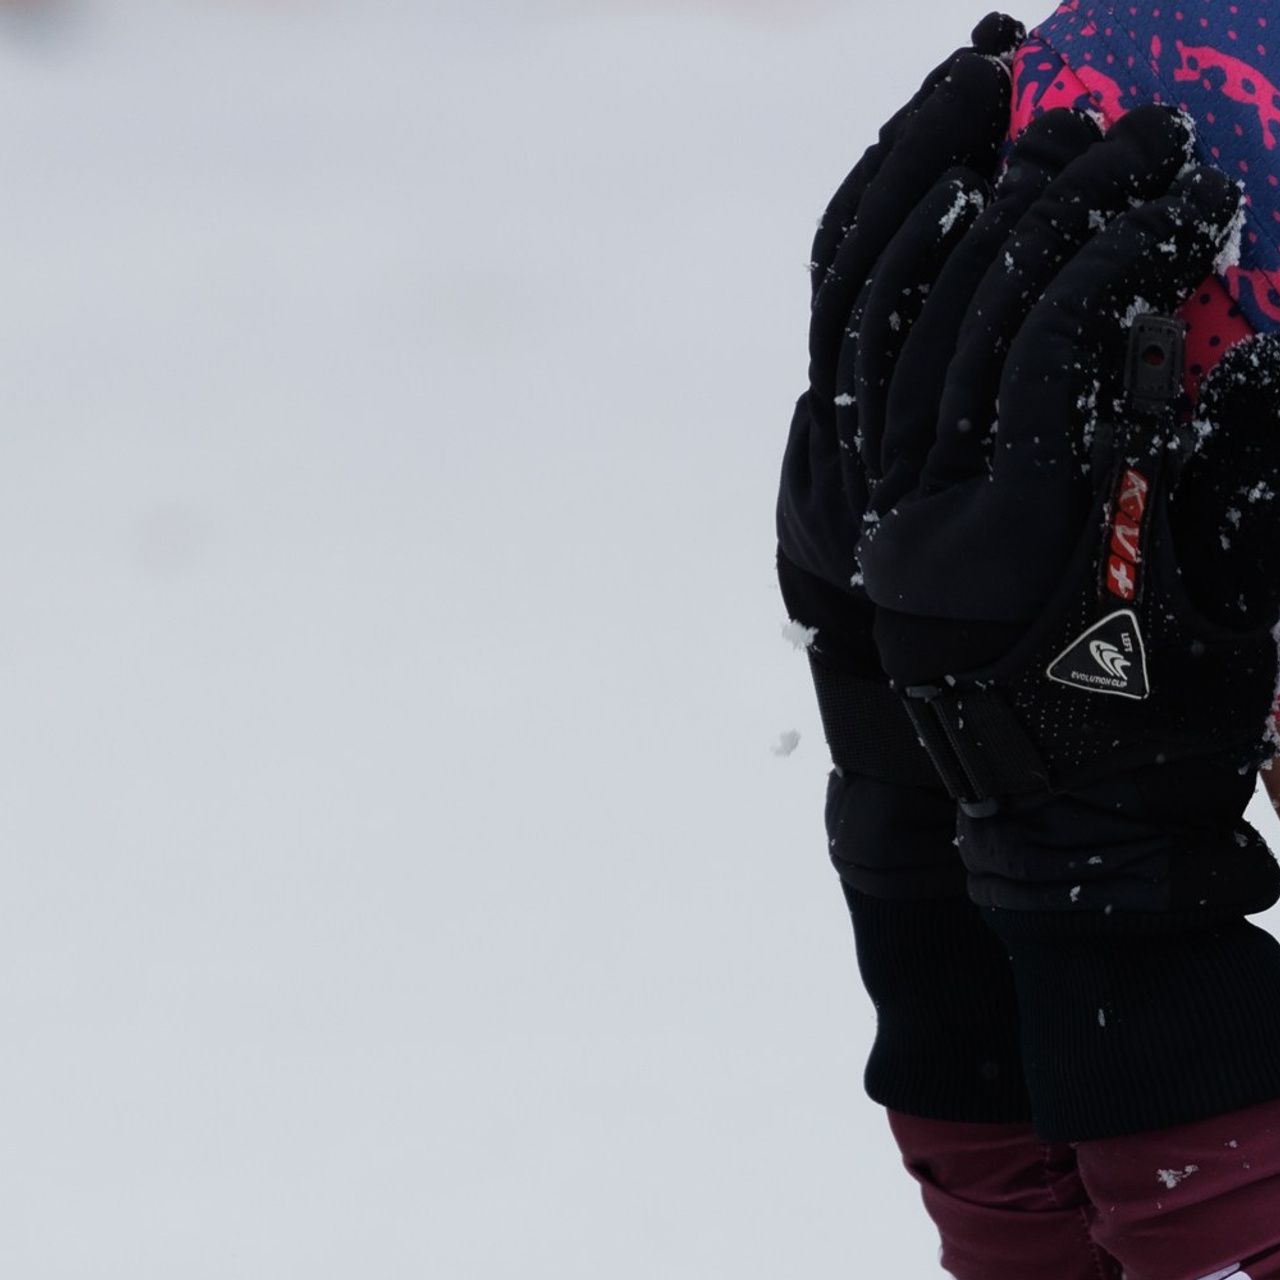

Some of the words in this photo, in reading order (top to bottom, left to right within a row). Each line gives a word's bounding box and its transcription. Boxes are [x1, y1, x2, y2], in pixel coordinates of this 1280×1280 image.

[1120, 632, 1133, 653] LEFT
[1071, 670, 1112, 685] EVOLUTION
[1111, 678, 1128, 688] CLIP
